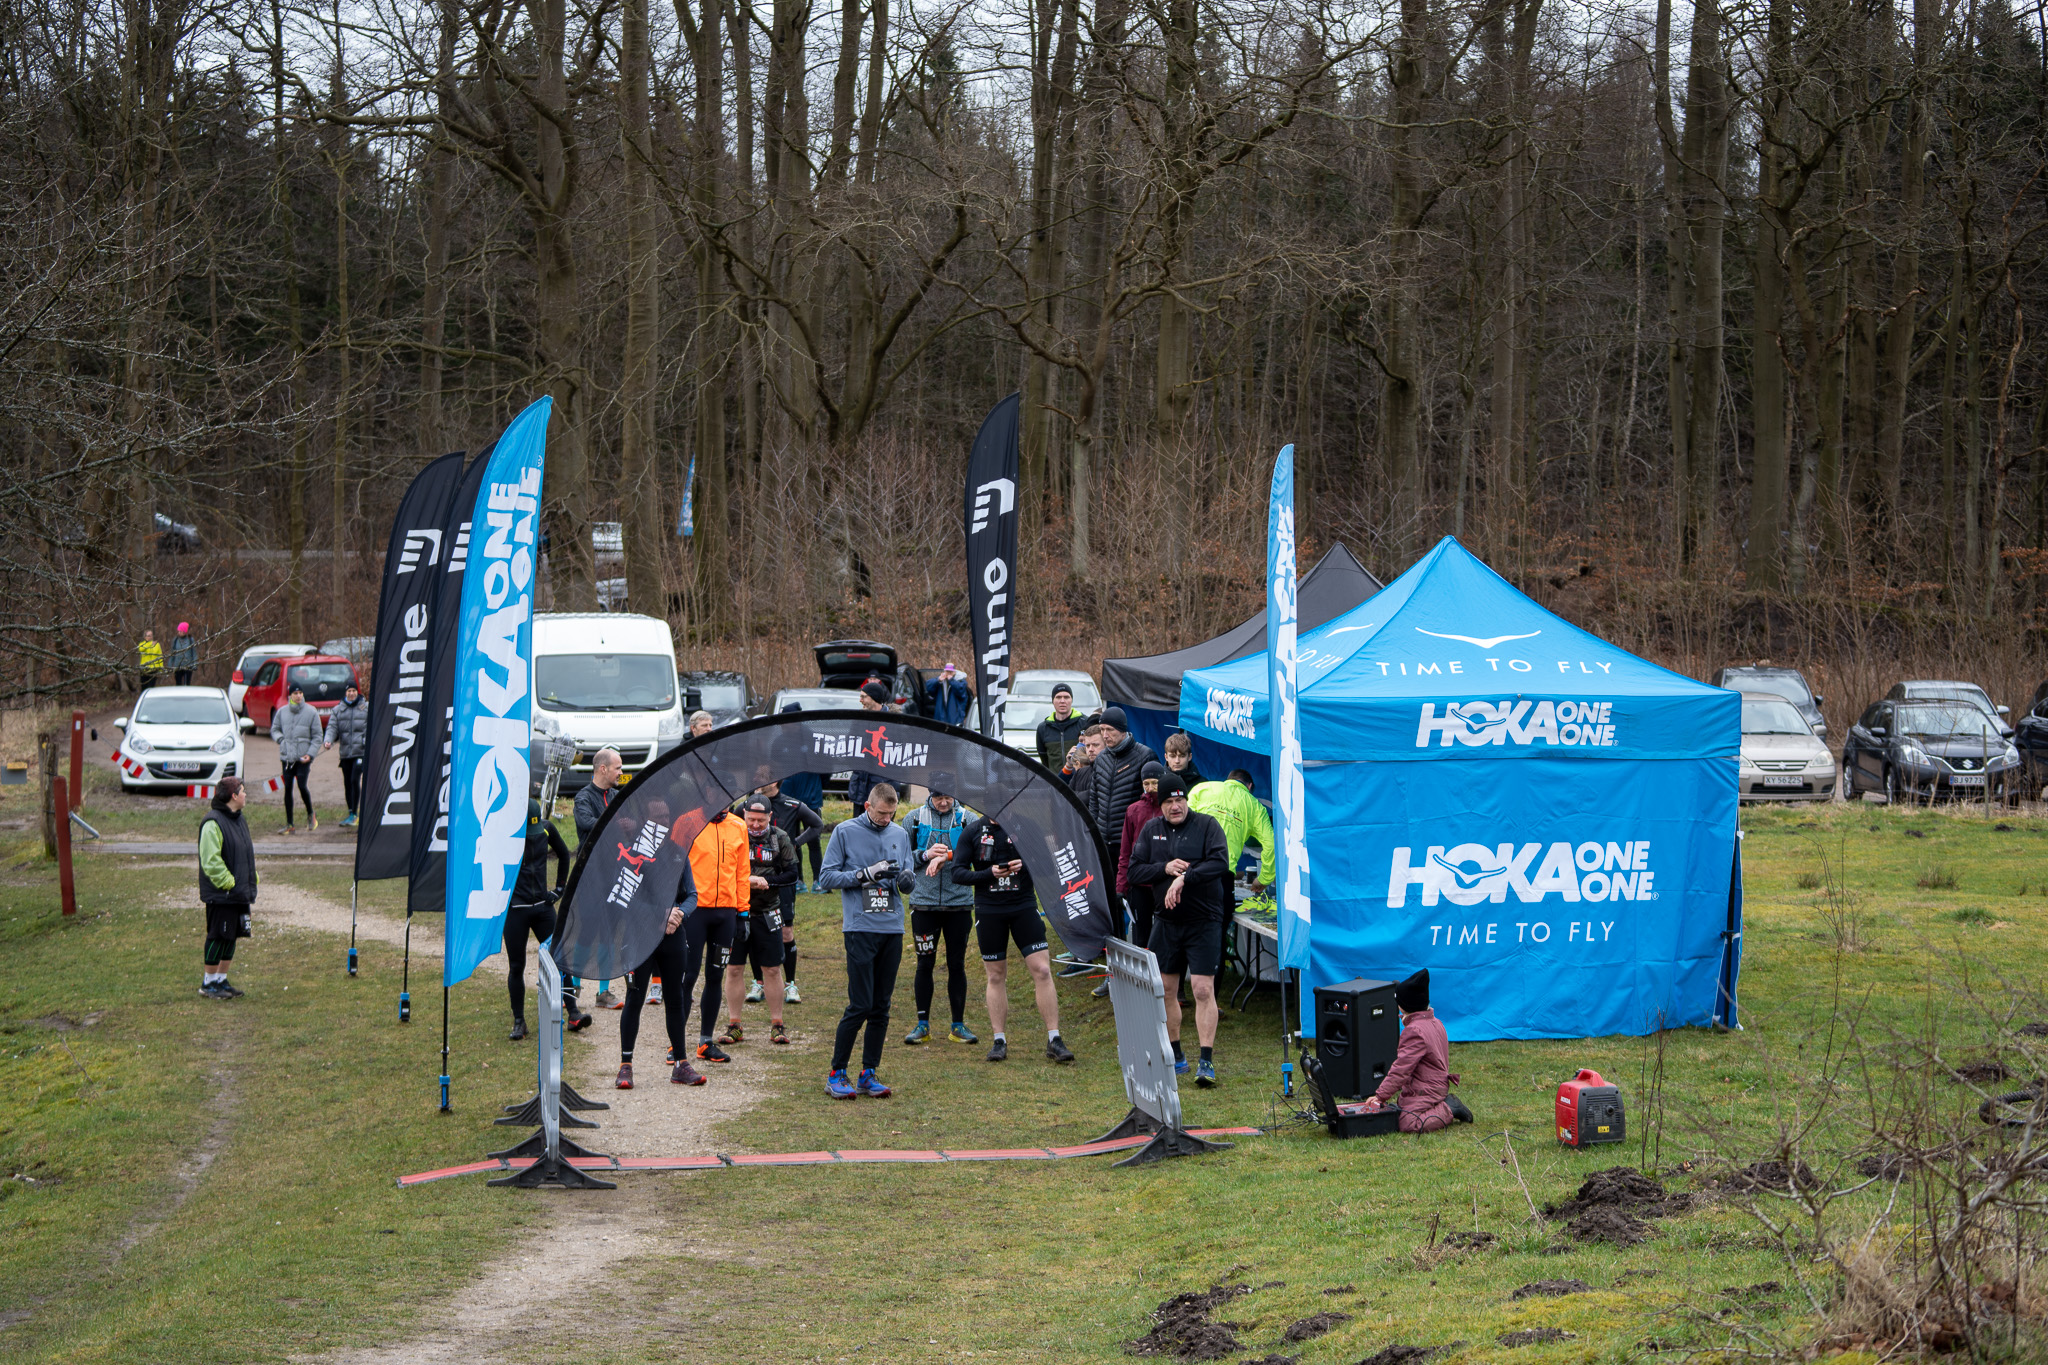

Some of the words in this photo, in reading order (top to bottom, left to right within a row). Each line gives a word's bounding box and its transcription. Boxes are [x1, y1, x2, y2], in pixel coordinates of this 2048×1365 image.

[510, 467, 541, 592] ONE
[483, 483, 519, 610] ONE
[1376, 660, 1464, 676] TIME
[1486, 658, 1532, 672] TO
[1557, 661, 1611, 674] FLY
[380, 603, 428, 825] newline
[1416, 700, 1560, 747] HOKA
[1556, 701, 1613, 724] ONE
[812, 732, 866, 758] TRAIL
[883, 740, 929, 766] MAN
[1559, 724, 1616, 746] ONE
[466, 593, 531, 919] HOKA
[1765, 776, 1776, 784] XY
[606, 866, 644, 909] TRAIL
[632, 819, 669, 858] MAN
[1054, 841, 1081, 886] TRAIL
[1387, 842, 1581, 908] HOKA
[1575, 841, 1650, 871] ONE
[998, 876, 1011, 886] 84
[1581, 871, 1655, 902] ONE
[870, 897, 889, 908] 295
[1064, 888, 1090, 920] MAN
[917, 940, 934, 951] 164
[1430, 923, 1497, 945] TIME
[1516, 922, 1551, 943] TO
[1569, 921, 1614, 942] FLY
